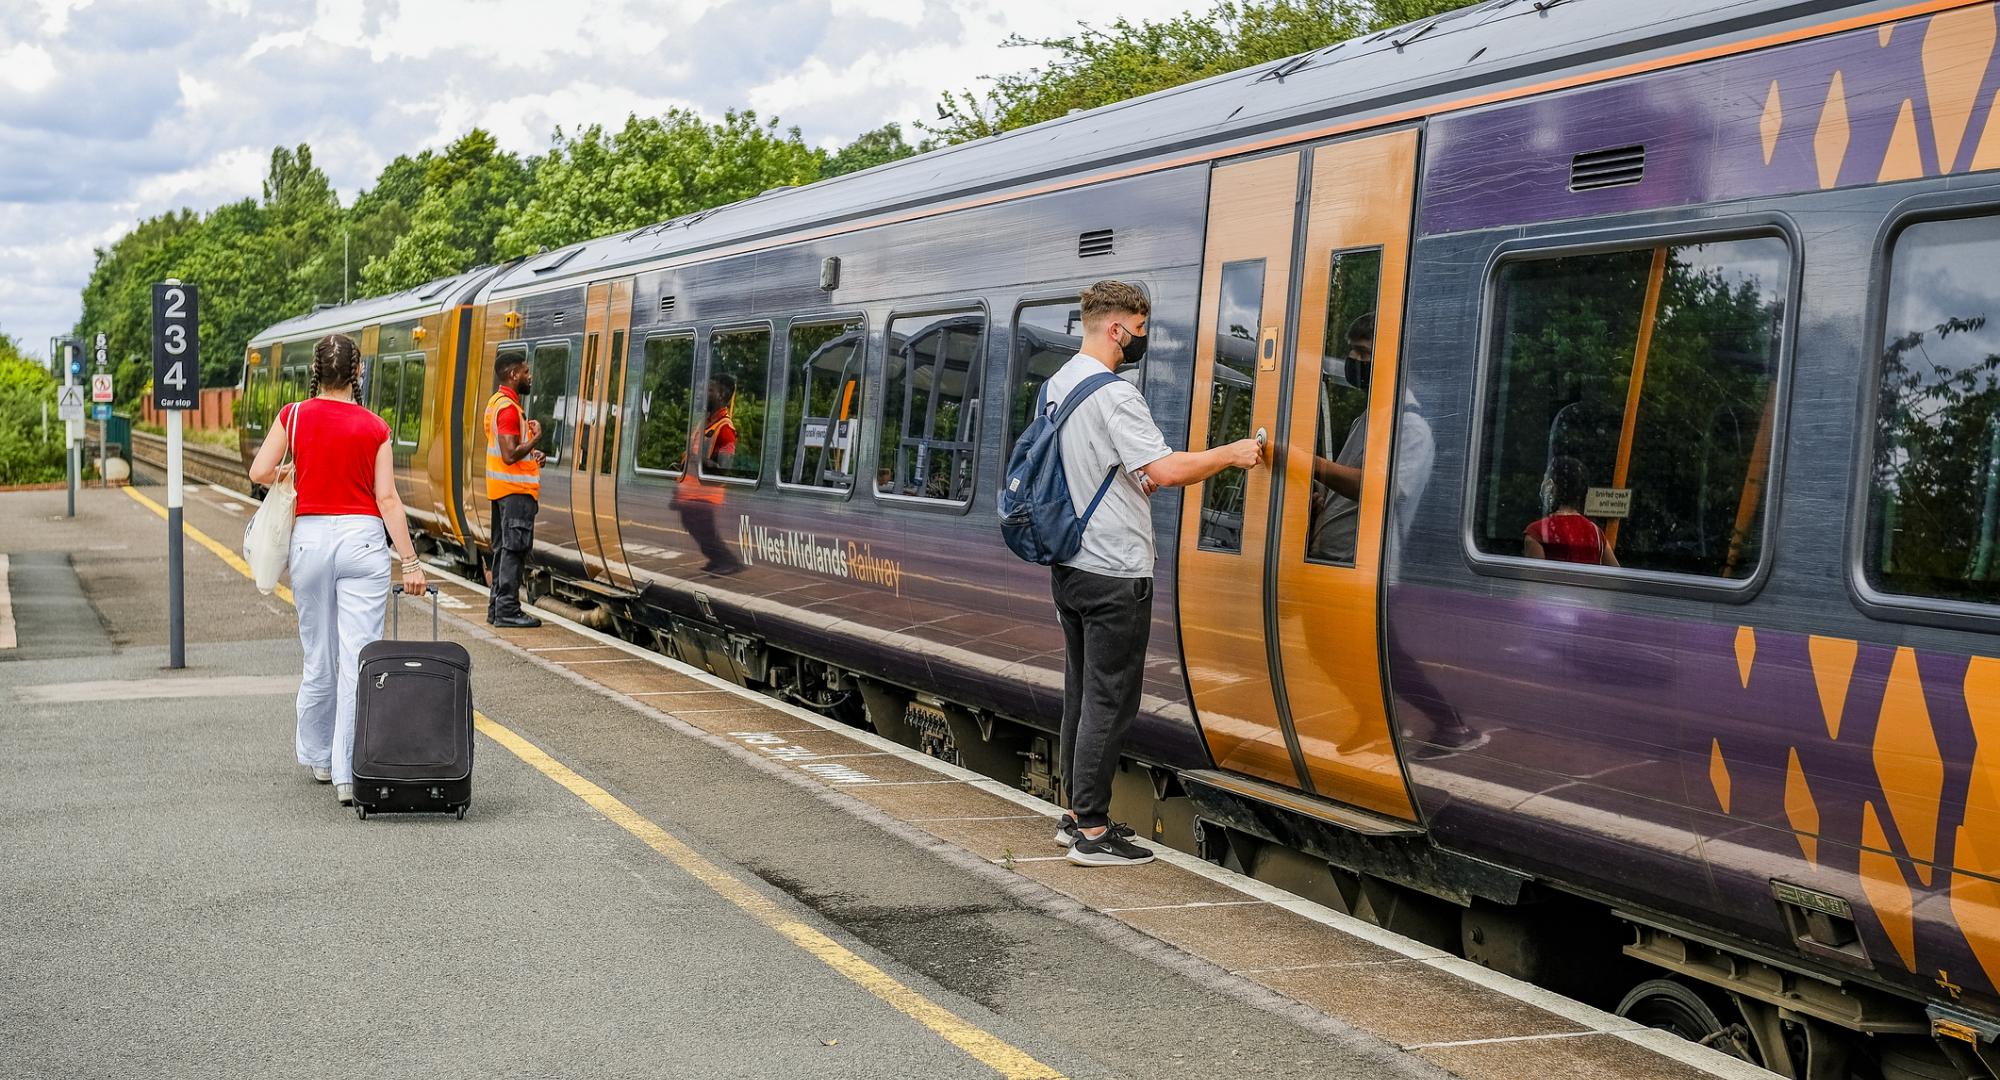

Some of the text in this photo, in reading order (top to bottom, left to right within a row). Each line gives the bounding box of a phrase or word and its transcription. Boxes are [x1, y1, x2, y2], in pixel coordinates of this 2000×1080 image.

[164, 288, 187, 318] 2
[164, 324, 187, 355] 3
[163, 361, 187, 391] 4
[160, 398, 192, 408] Car stop
[754, 525, 900, 598] West Midlands Railway
